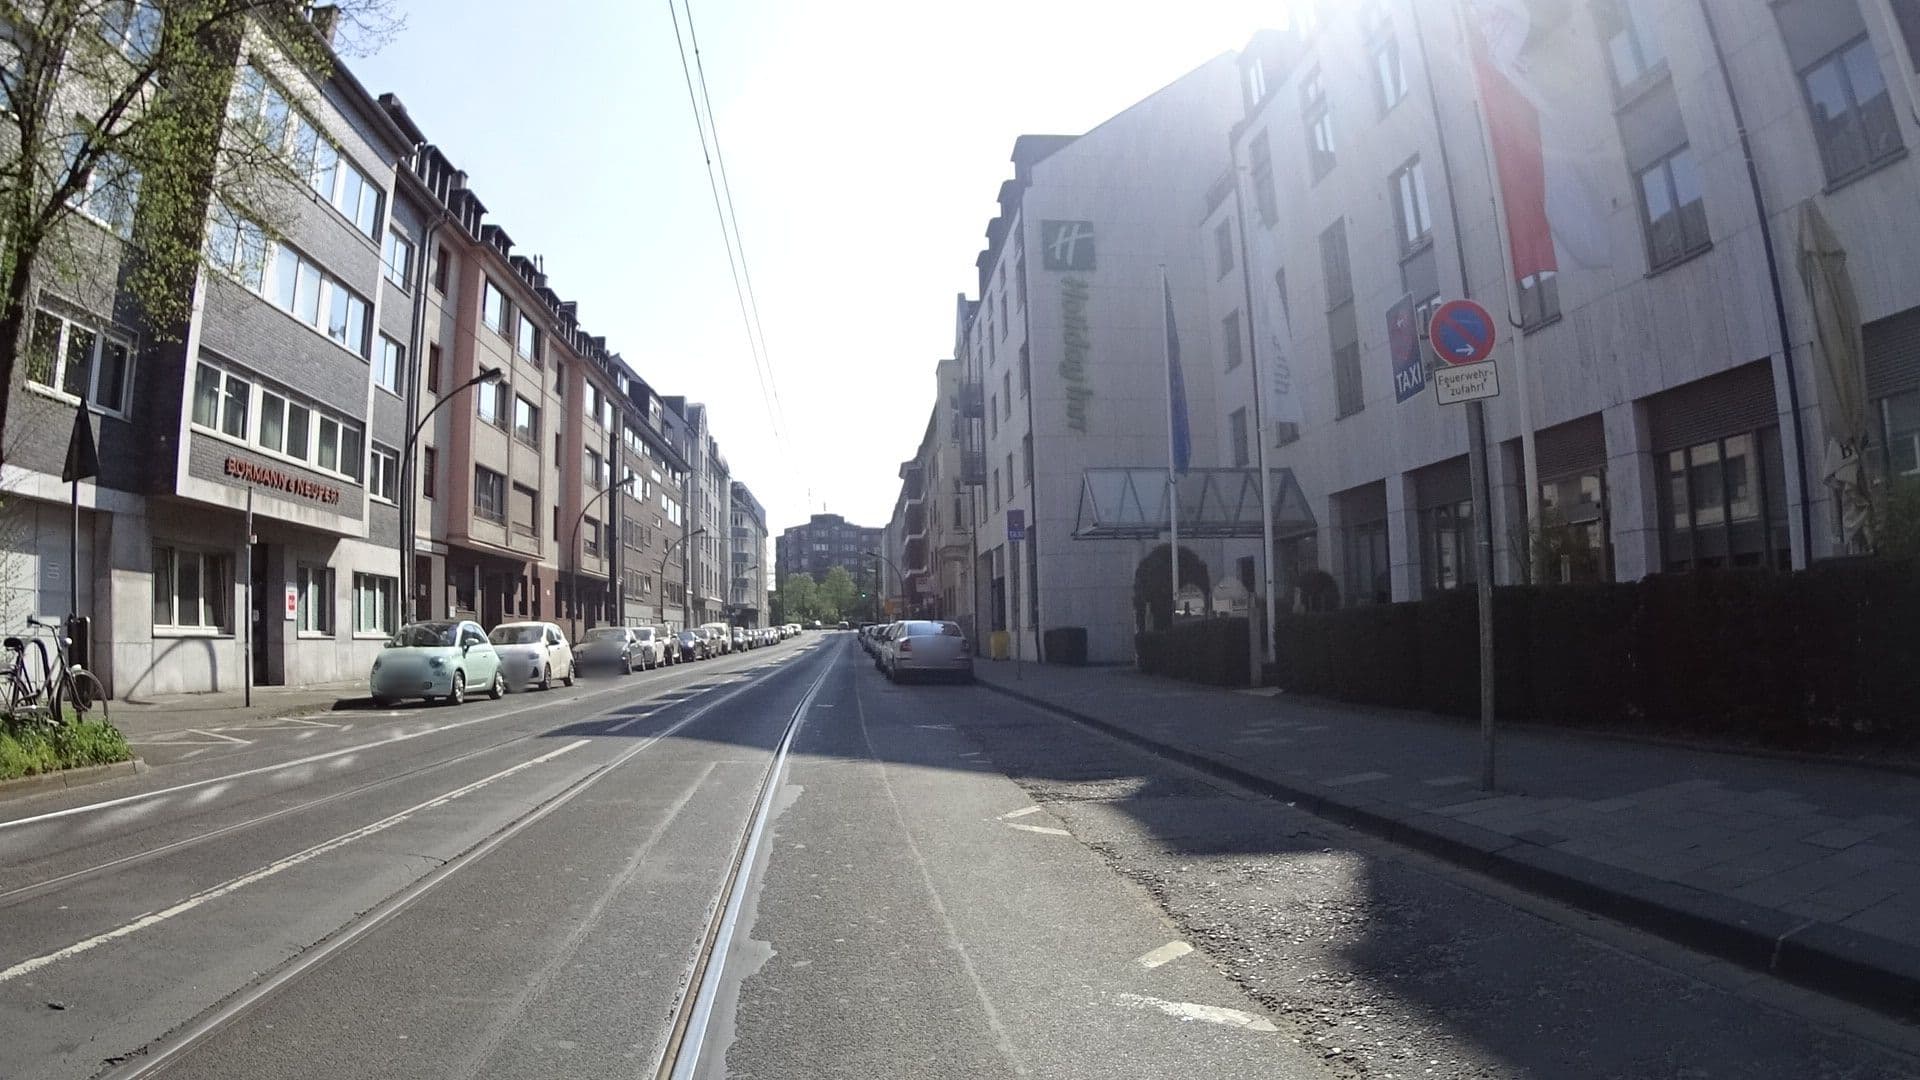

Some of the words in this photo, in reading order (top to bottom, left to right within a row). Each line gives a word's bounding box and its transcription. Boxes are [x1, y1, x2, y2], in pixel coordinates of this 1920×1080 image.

[1396, 361, 1422, 393] TAXI
[1438, 368, 1494, 385] Feuerwehr-
[1450, 382, 1485, 396] zufahrt
[225, 456, 286, 490] BORMANN
